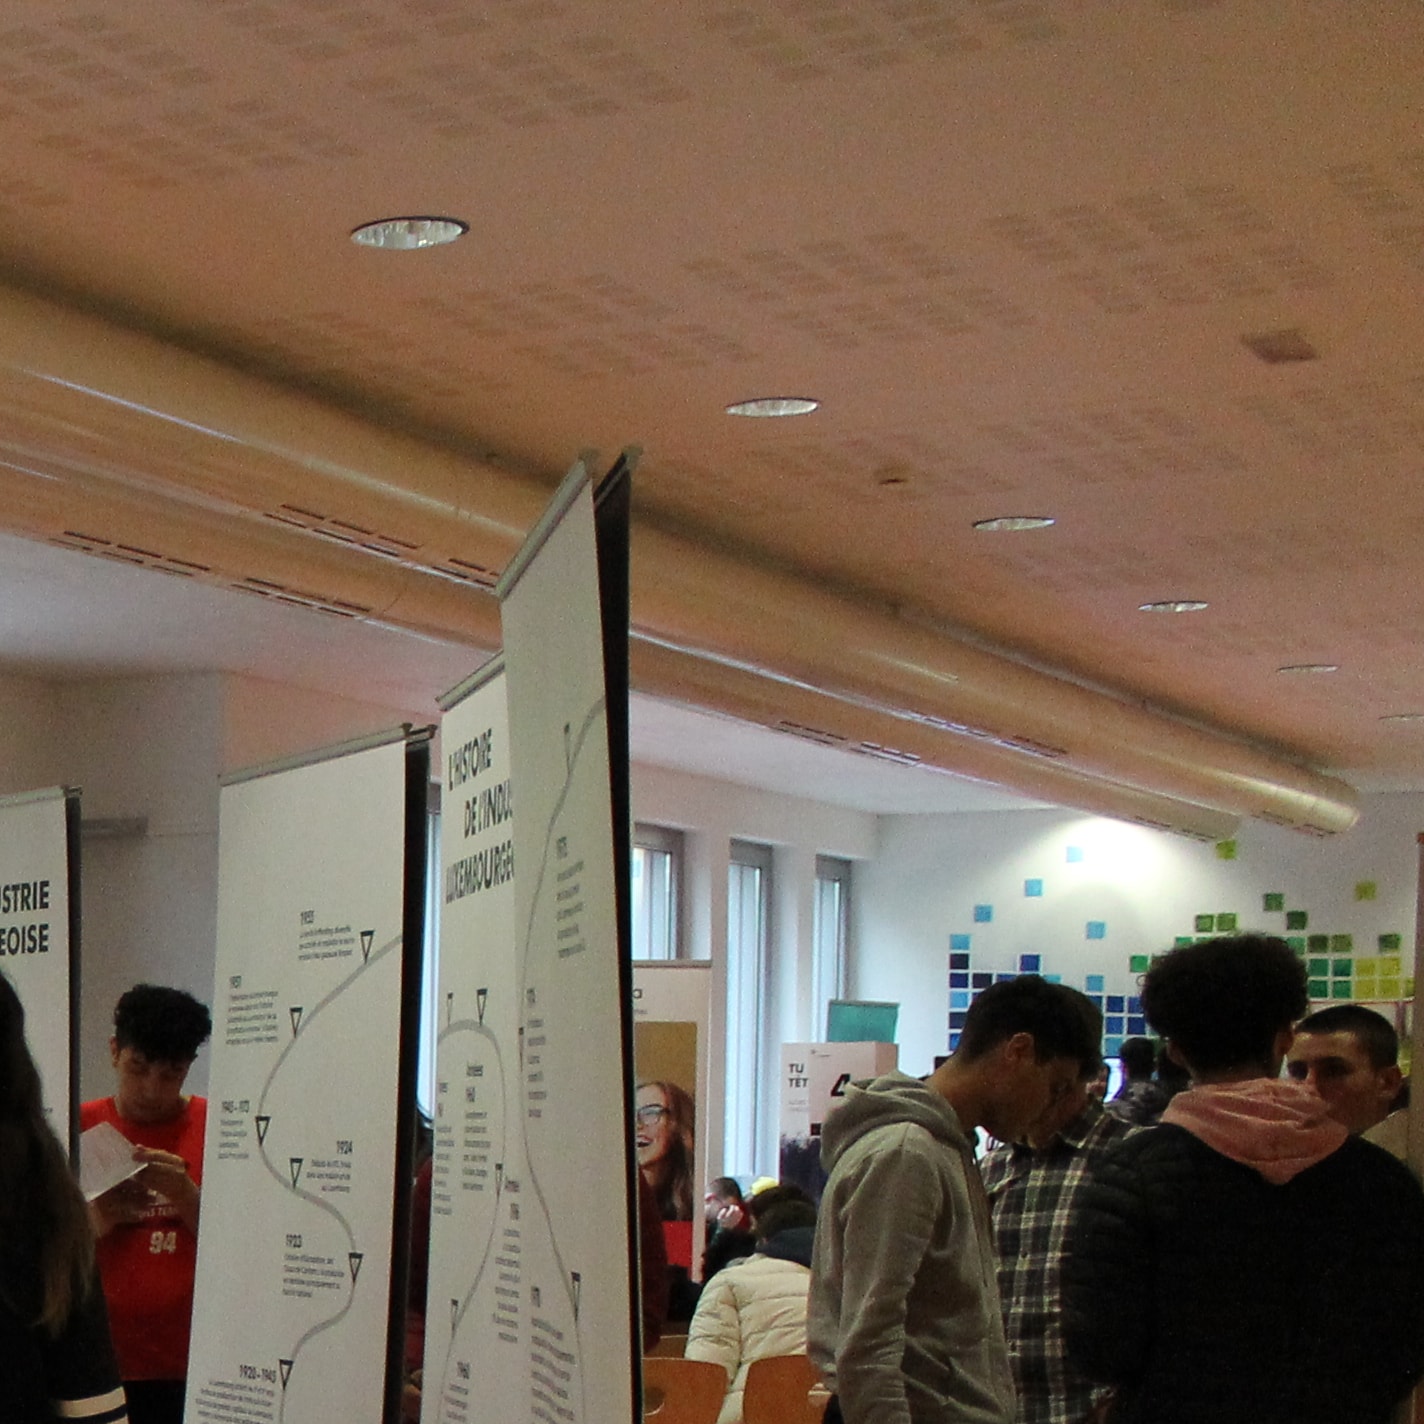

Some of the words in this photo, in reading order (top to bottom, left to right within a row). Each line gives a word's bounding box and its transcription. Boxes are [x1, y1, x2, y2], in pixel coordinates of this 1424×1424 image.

[464, 796, 477, 839] DE
[478, 778, 513, 833] L'INDU
[150, 1231, 177, 1255] 94
